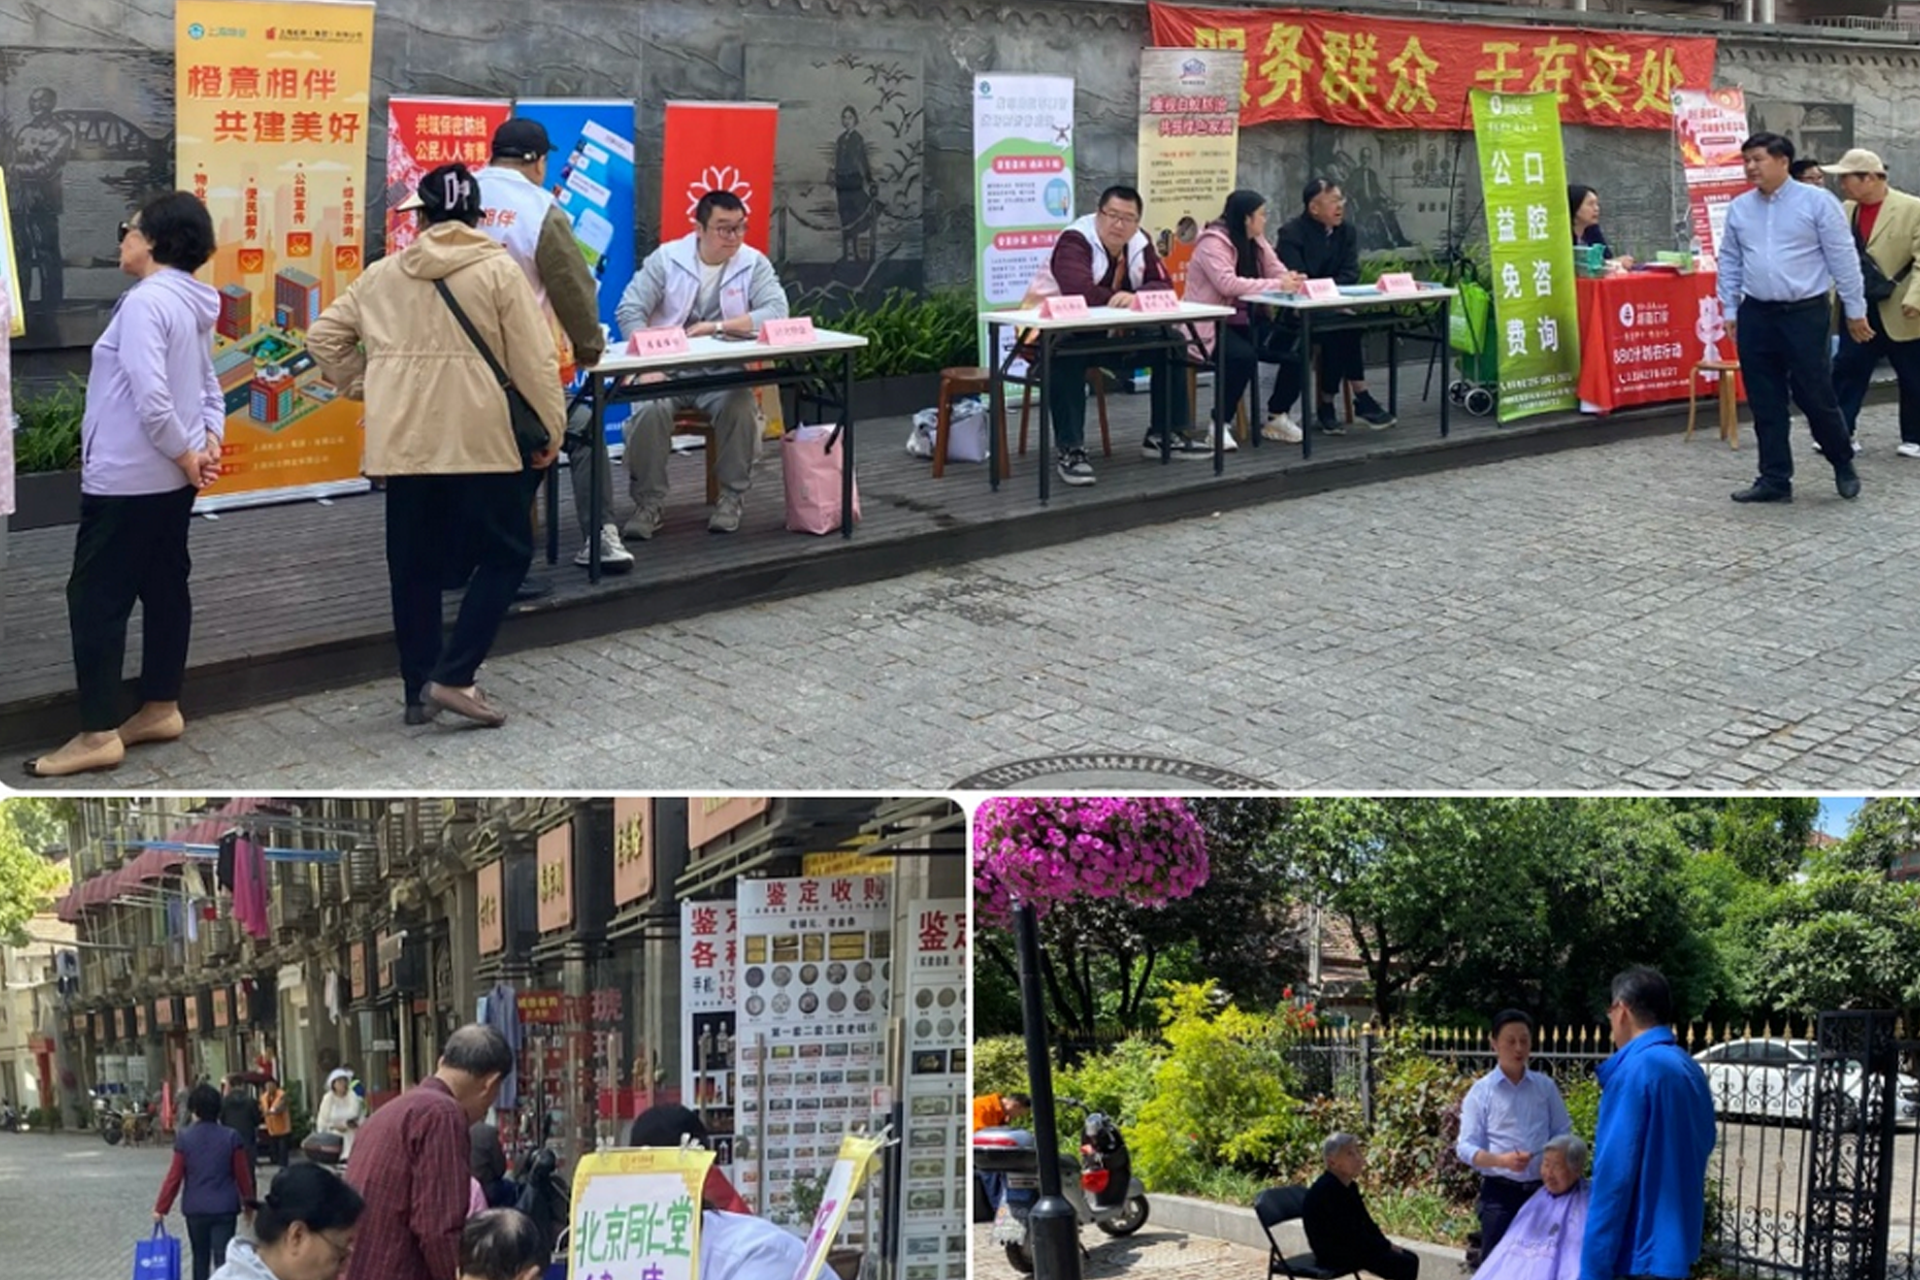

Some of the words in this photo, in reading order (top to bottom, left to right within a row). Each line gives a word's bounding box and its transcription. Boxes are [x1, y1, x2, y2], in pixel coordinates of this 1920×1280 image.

[188, 66, 337, 100] 橙意相伴
[214, 111, 361, 143] 共建美好
[415, 141, 489, 162] 公民人人有责
[576, 1196, 693, 1267] 北京同仁堂
